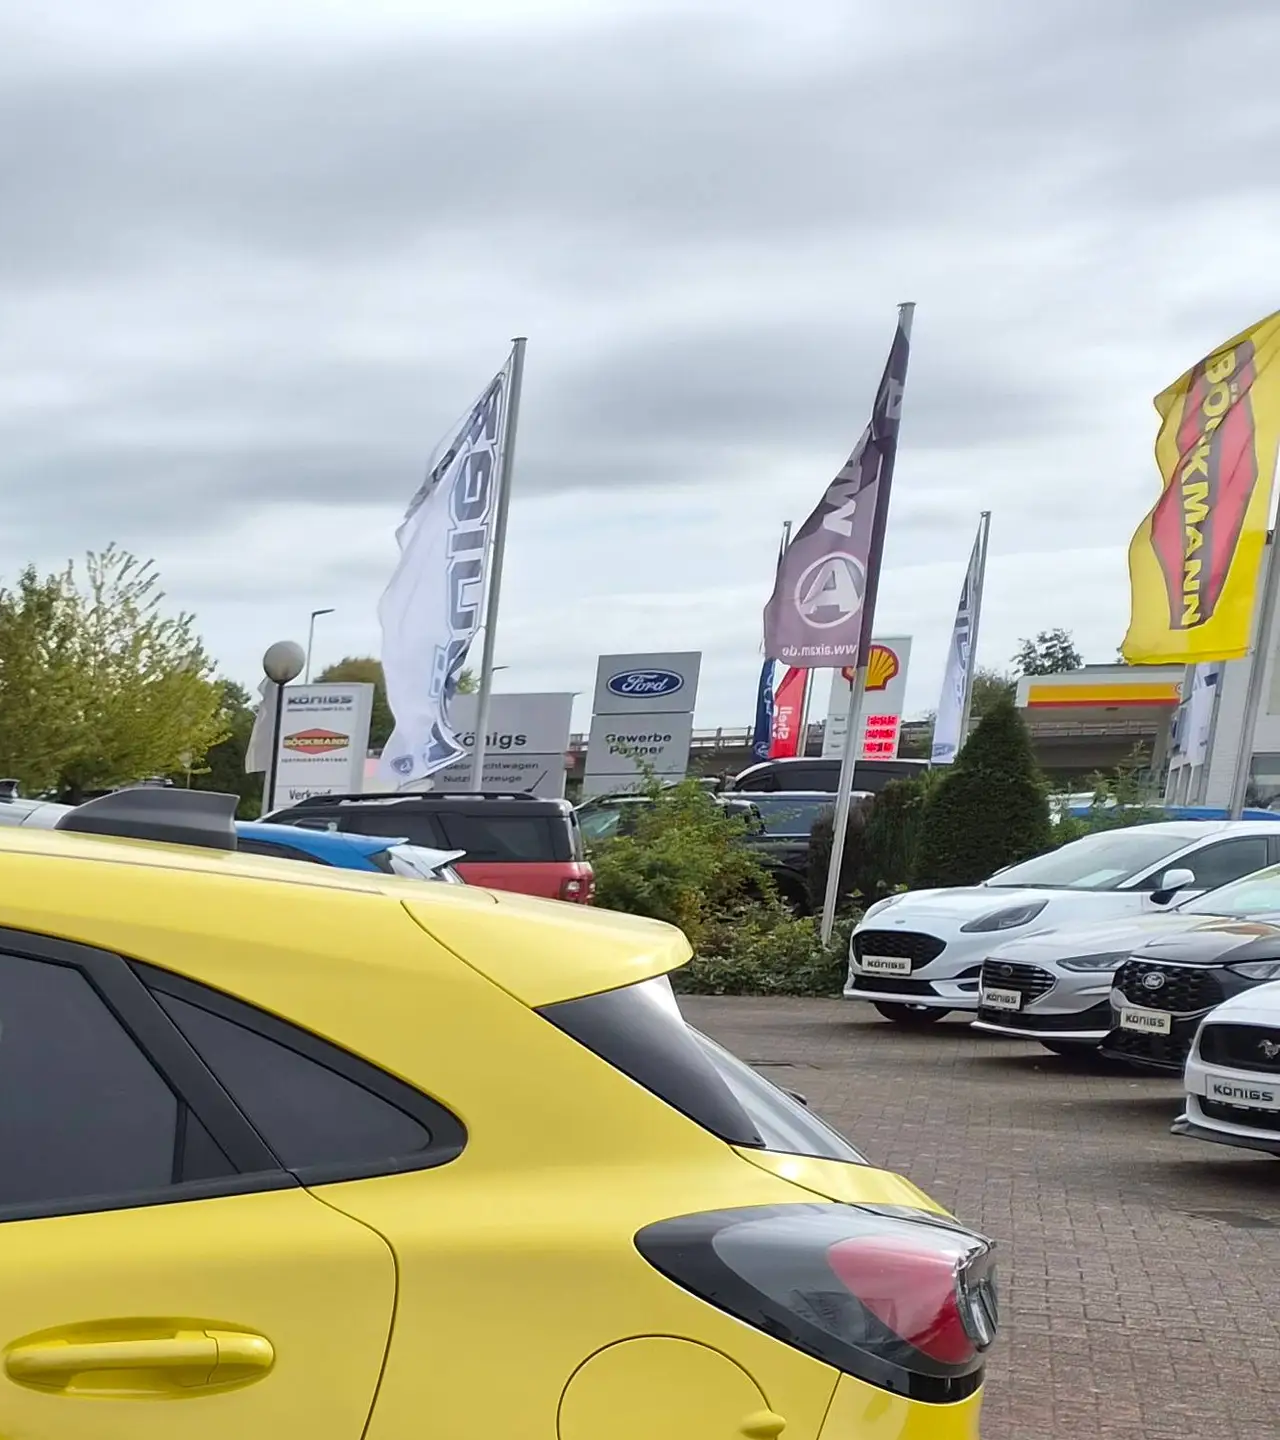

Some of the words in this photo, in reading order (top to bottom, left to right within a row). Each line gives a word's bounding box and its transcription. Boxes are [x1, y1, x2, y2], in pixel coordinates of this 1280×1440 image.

[621, 673, 669, 692] Ford
[605, 733, 672, 743] Gewerbe
[609, 745, 664, 756] Partner
[443, 762, 539, 771] Gebrchtwagen
[443, 775, 523, 784] Nutzrzeuge
[1125, 1012, 1165, 1028] KÖNIGS
[1213, 1082, 1274, 1102] KÖNIGS
